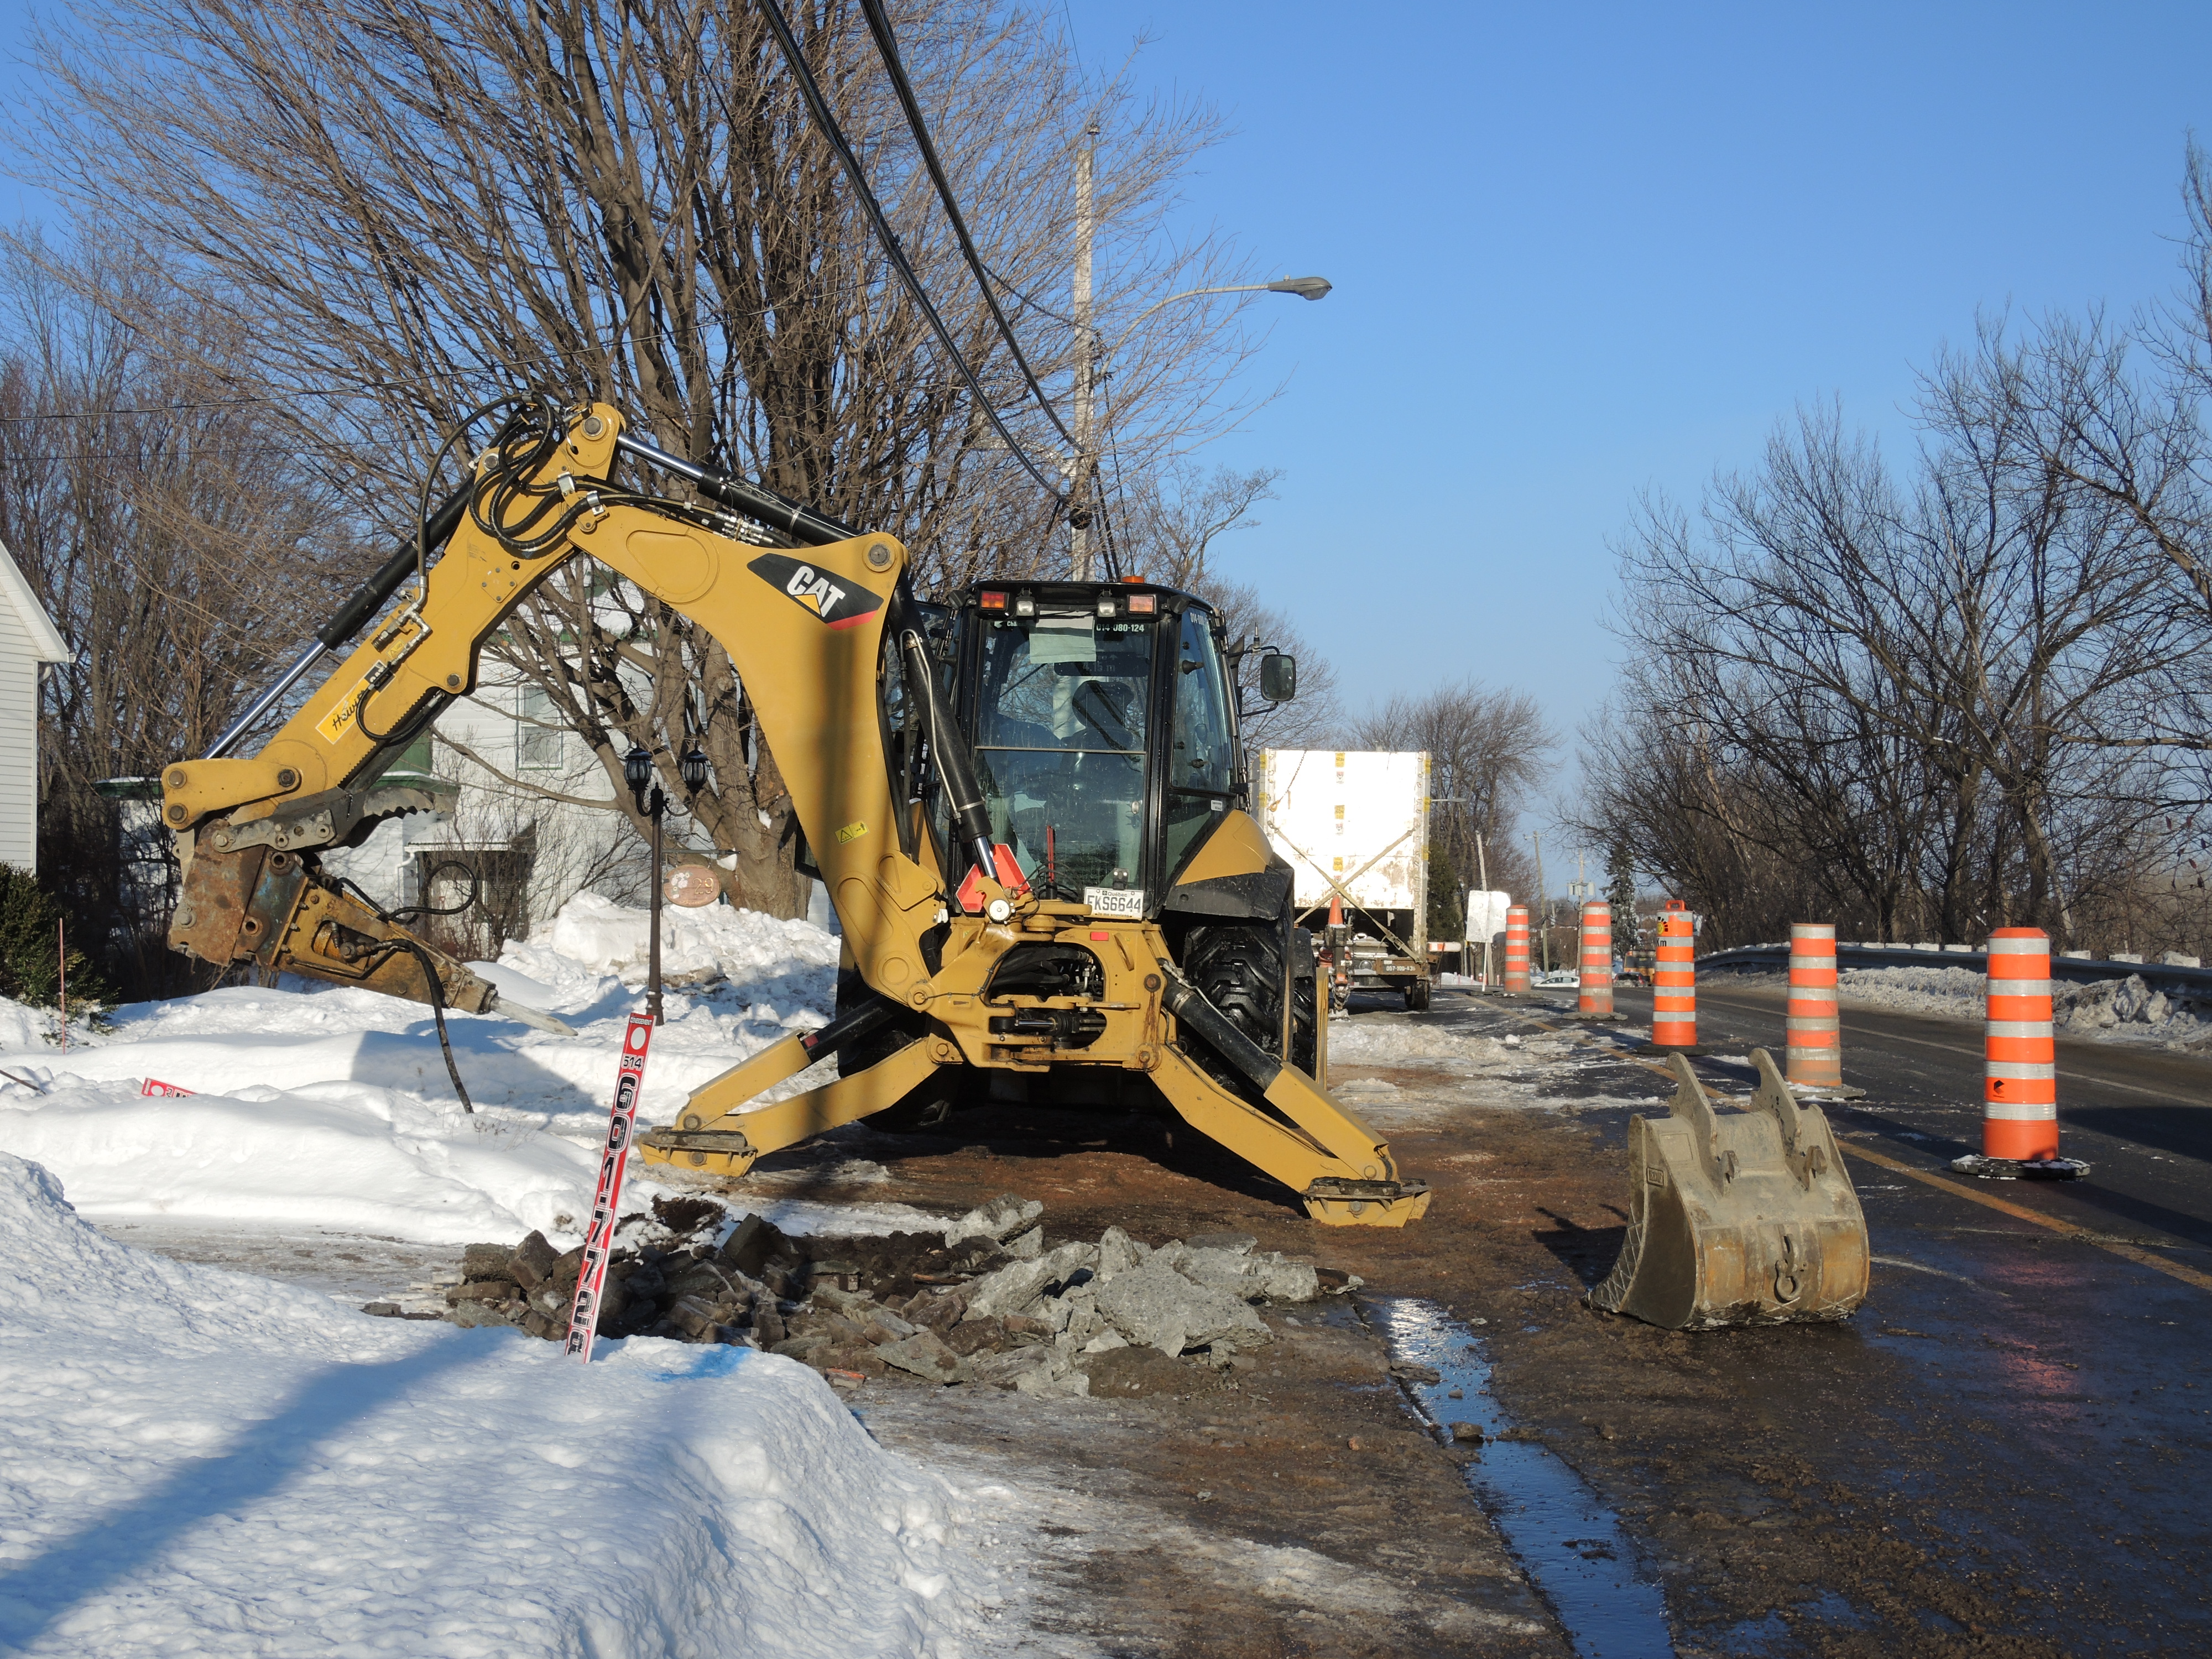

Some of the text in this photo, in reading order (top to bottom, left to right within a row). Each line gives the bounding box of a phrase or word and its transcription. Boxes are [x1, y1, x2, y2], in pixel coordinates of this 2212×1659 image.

[787, 566, 846, 617] CAT
[1096, 624, 1145, 632] 014-080-124
[692, 878, 714, 895] 29
[622, 1055, 643, 1070] 514
